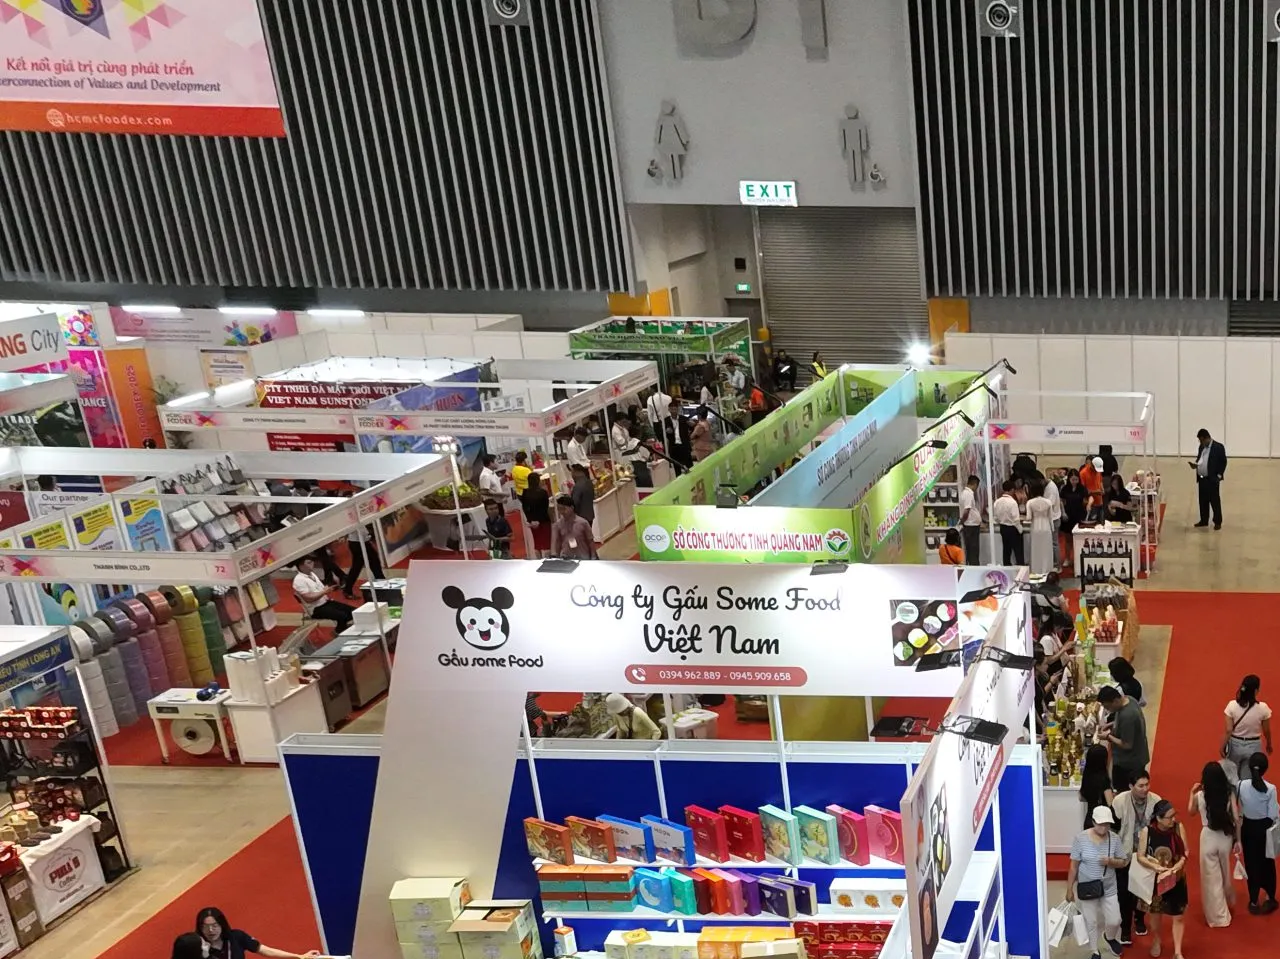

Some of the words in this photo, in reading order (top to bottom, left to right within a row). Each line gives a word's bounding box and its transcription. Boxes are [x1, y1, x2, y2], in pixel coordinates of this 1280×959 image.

[6, 57, 27, 71] Kết
[31, 57, 50, 72] nối
[54, 60, 73, 75] giá
[78, 61, 93, 75] trị
[96, 61, 127, 76] cùng
[131, 61, 160, 76] phát
[163, 59, 194, 76] triển
[74, 77, 86, 89] of
[88, 78, 123, 89] Values
[127, 79, 147, 90] and
[151, 80, 221, 93] Development
[746, 184, 793, 199] EXIT
[30, 328, 60, 354] City
[284, 385, 309, 393] TNHH
[266, 395, 291, 404] VIET
[295, 397, 318, 405] NAM
[4, 415, 39, 425] TRADE
[686, 528, 710, 549] CÔNG
[711, 529, 748, 550] THƯƠNG
[771, 528, 801, 552] QUẢNG
[802, 534, 823, 551] NAM
[570, 584, 624, 619] Công
[632, 584, 655, 620] ty
[662, 585, 708, 621] Gấu
[717, 586, 779, 610] Some
[785, 587, 842, 611] Food
[643, 623, 703, 660] Việt
[708, 625, 780, 655] Nam
[471, 656, 506, 668] some
[659, 670, 721, 681] 0394.962.889
[730, 671, 792, 682] 0945.909.658
